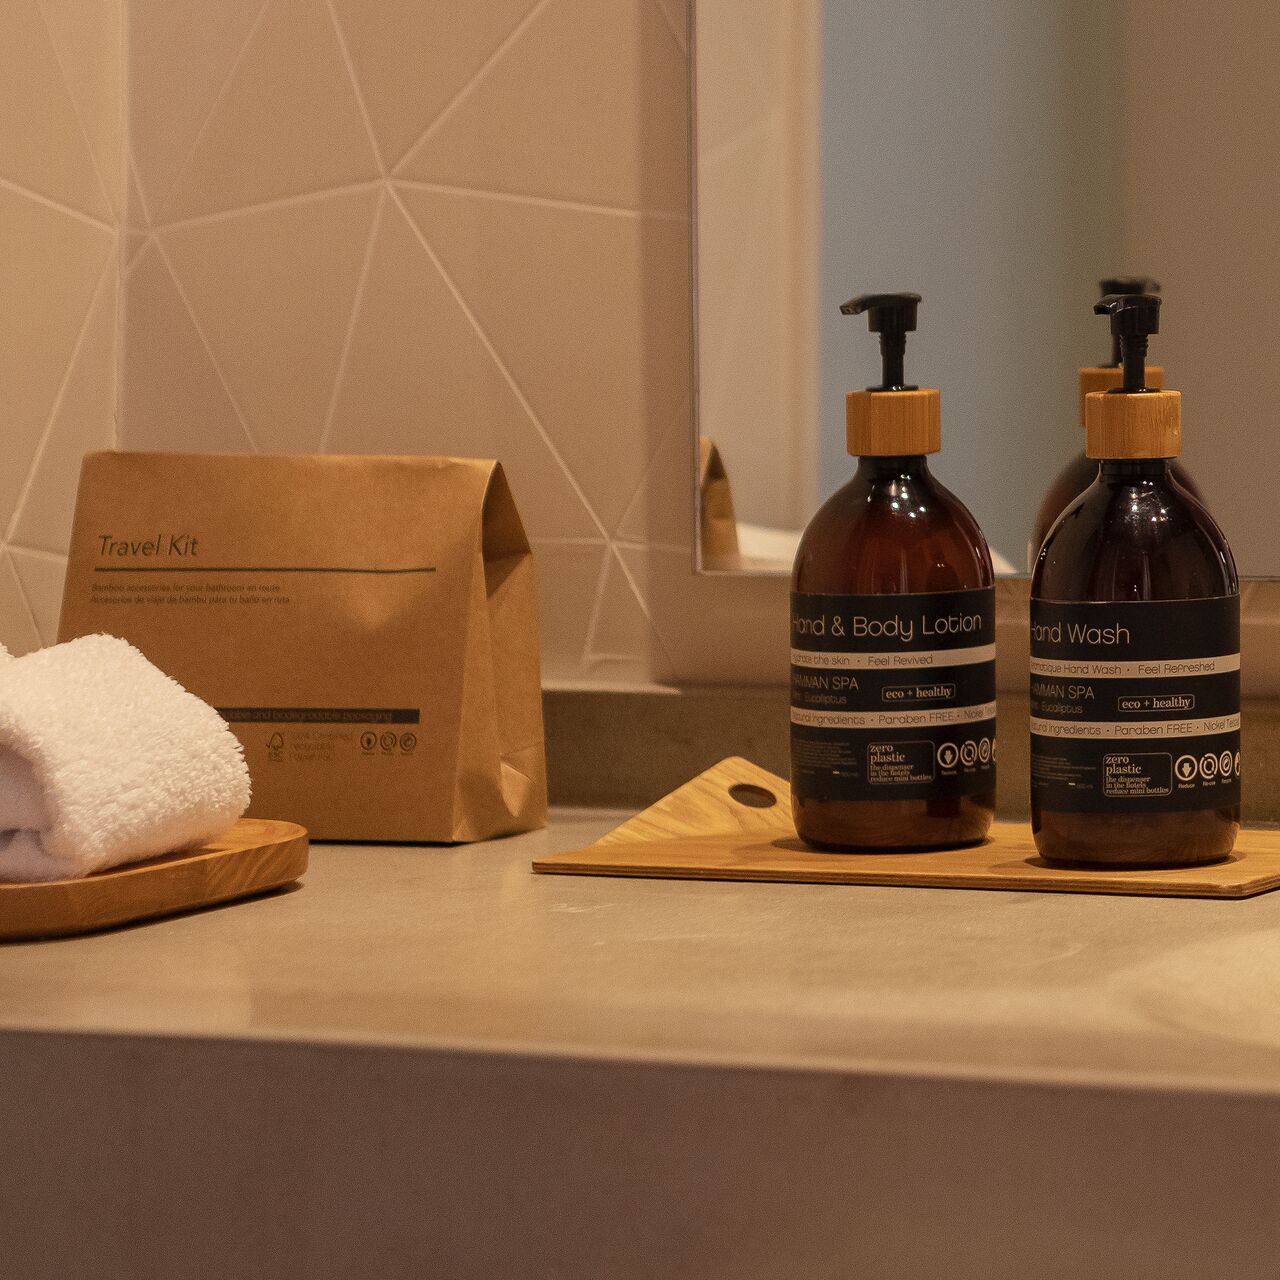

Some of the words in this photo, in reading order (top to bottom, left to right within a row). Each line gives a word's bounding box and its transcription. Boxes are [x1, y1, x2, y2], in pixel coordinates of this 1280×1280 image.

[98, 534, 162, 557] Travel
[168, 534, 199, 557] Kit
[831, 615, 846, 637] &
[853, 614, 914, 642] Body
[922, 612, 983, 636] Lotion
[1067, 622, 1131, 645] Wash
[813, 653, 830, 665] the
[831, 654, 850, 666] skin
[867, 655, 891, 666] Feel
[893, 653, 934, 666] Revived
[1063, 664, 1089, 675] Hand
[1091, 664, 1122, 675] Wash
[1138, 664, 1161, 675] Feel
[1164, 661, 1216, 674] Refreshed
[831, 675, 860, 691] SPA
[885, 689, 905, 700] eco
[915, 686, 953, 702] healthy
[1067, 684, 1096, 700] SPA
[1121, 700, 1141, 710] eco
[1152, 696, 1192, 710] healthy
[878, 713, 927, 725] Paraben
[929, 711, 954, 723] FREE
[1114, 725, 1164, 736] Paraben
[1166, 722, 1193, 734] FREE
[870, 744, 894, 753] zero
[870, 751, 906, 765] plastic
[1105, 756, 1130, 764] zero
[1105, 763, 1142, 777] plastic
[1146, 786, 1169, 794] bottles
